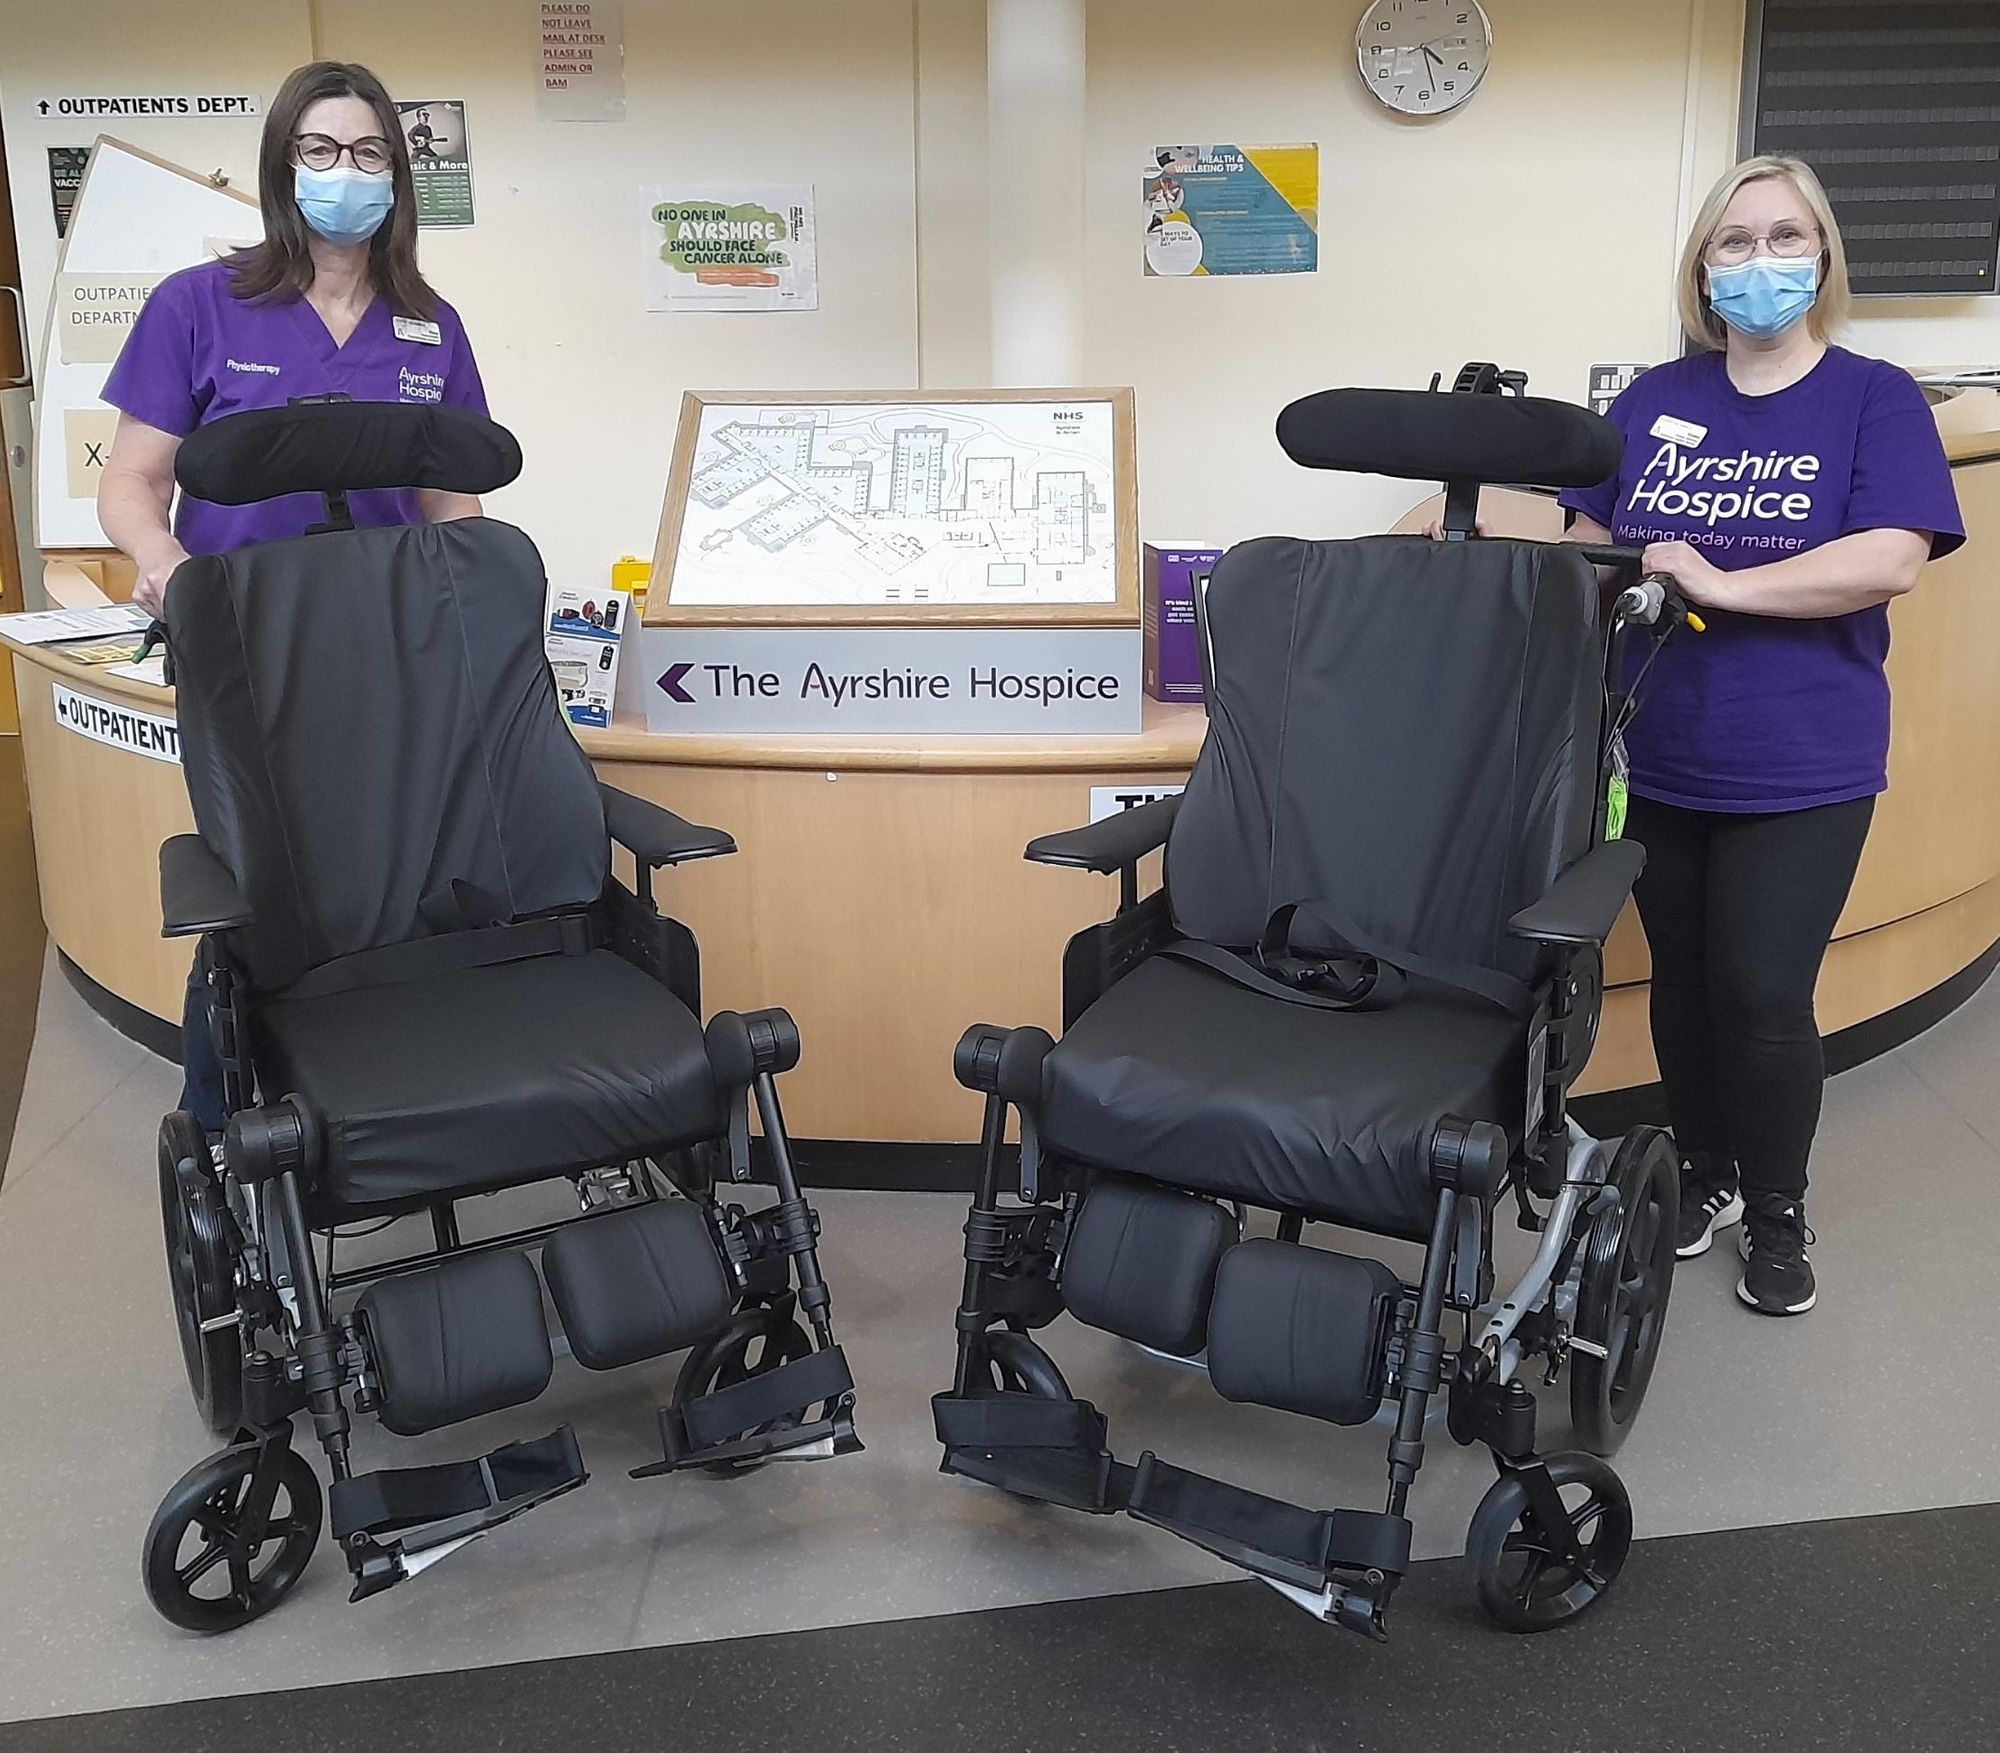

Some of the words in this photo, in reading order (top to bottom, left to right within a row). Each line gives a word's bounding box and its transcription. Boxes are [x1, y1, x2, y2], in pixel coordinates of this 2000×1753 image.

[541, 4, 572, 13] PLEASE
[576, 4, 590, 13] DO
[1456, 13, 1468, 23] 2
[542, 19, 560, 28] NOT
[564, 19, 591, 28] LEAVE
[1376, 21, 1391, 31] 10
[543, 34, 565, 43] MAIL
[568, 34, 580, 42] AT
[583, 34, 605, 43] DESK
[544, 49, 574, 58] PLEASE
[578, 49, 592, 58] SEE
[545, 64, 577, 72] ADMIN
[579, 64, 592, 72] OR
[1457, 61, 1468, 71] 4
[1378, 68, 1389, 78] 8
[1393, 85, 1405, 95] 7
[1443, 81, 1454, 91] 5
[1418, 90, 1430, 100] 6
[58, 98, 189, 114] OUTPATIENTS
[197, 97, 255, 113] DEPT.
[1202, 154, 1236, 164] HEALTH
[429, 161, 436, 170] &
[439, 160, 468, 170] More
[1174, 164, 1224, 173] WELLBEING
[1225, 163, 1244, 172] TIPS
[658, 209, 677, 221] NO
[680, 210, 709, 221] ONE
[712, 209, 726, 220] IN
[678, 221, 776, 240] AYRSHIRE
[670, 240, 722, 252] SHOULD
[725, 240, 756, 251] FACE
[684, 253, 735, 264] CANCER
[738, 253, 782, 264] ALONE
[74, 287, 153, 301] OUTPATIE
[399, 366, 444, 387] Ayrshir
[399, 381, 442, 401] Hospic
[1053, 411, 1084, 420] NHS
[1643, 442, 1820, 486] Ayrshire
[1627, 479, 1811, 527] Hospice
[1617, 525, 1675, 542] Making
[1683, 530, 1735, 548] today
[1741, 533, 1806, 550] matter
[703, 664, 779, 697] The
[801, 661, 950, 708] Ayrshire
[970, 666, 1119, 707] Hospice
[69, 696, 178, 756] OUTPATIENT
